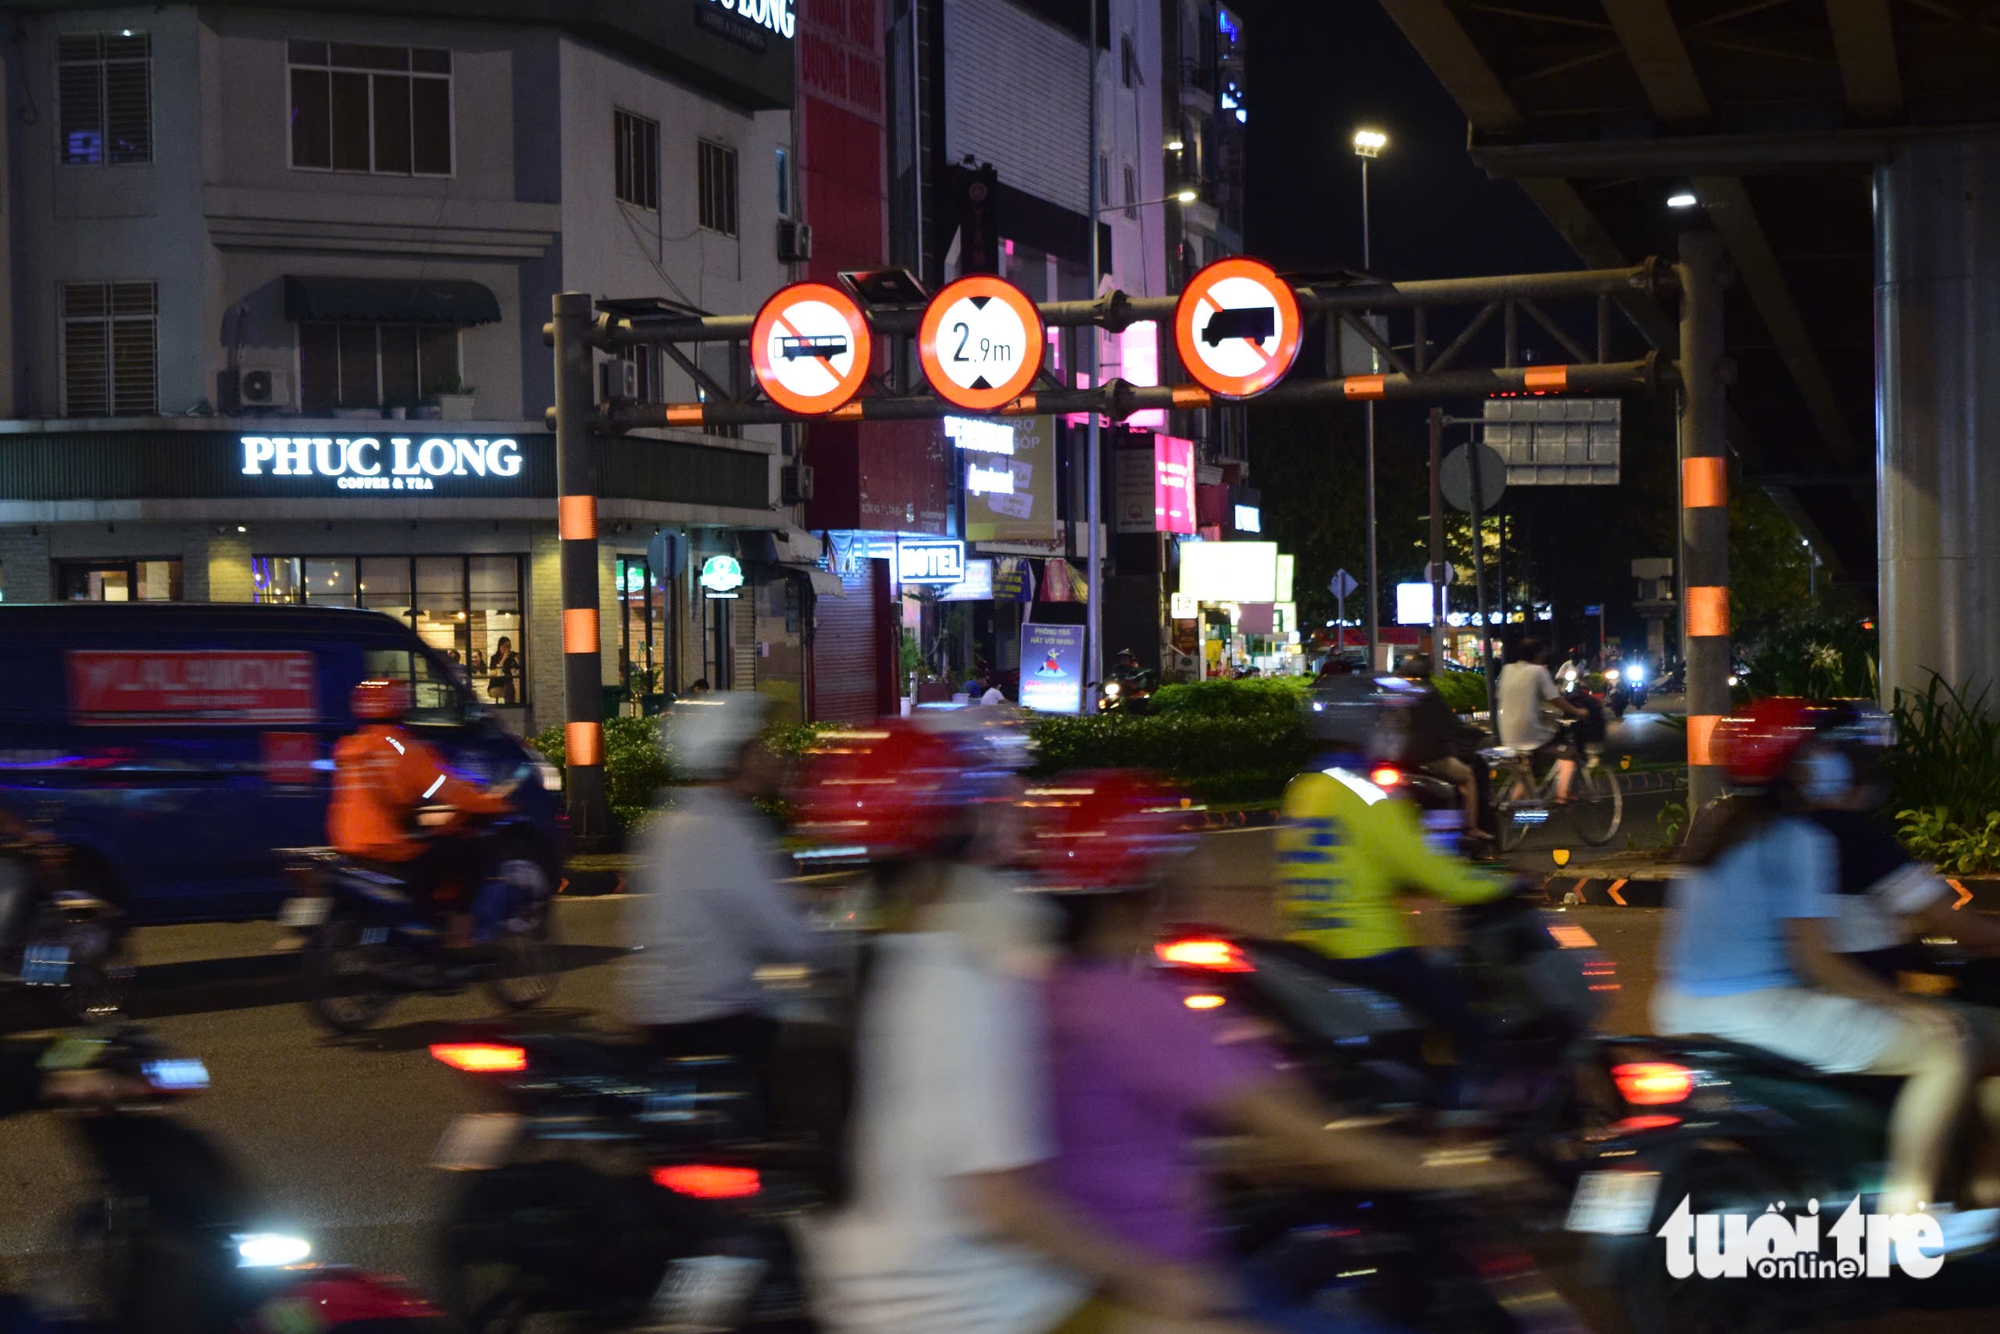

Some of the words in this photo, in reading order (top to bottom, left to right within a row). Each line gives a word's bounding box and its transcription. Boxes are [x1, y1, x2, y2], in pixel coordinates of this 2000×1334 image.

[240, 436, 382, 477] PHUC
[390, 437, 523, 477] LONG
[337, 477, 391, 490] COFFEE
[392, 478, 404, 489] &
[406, 477, 434, 490] TEA
